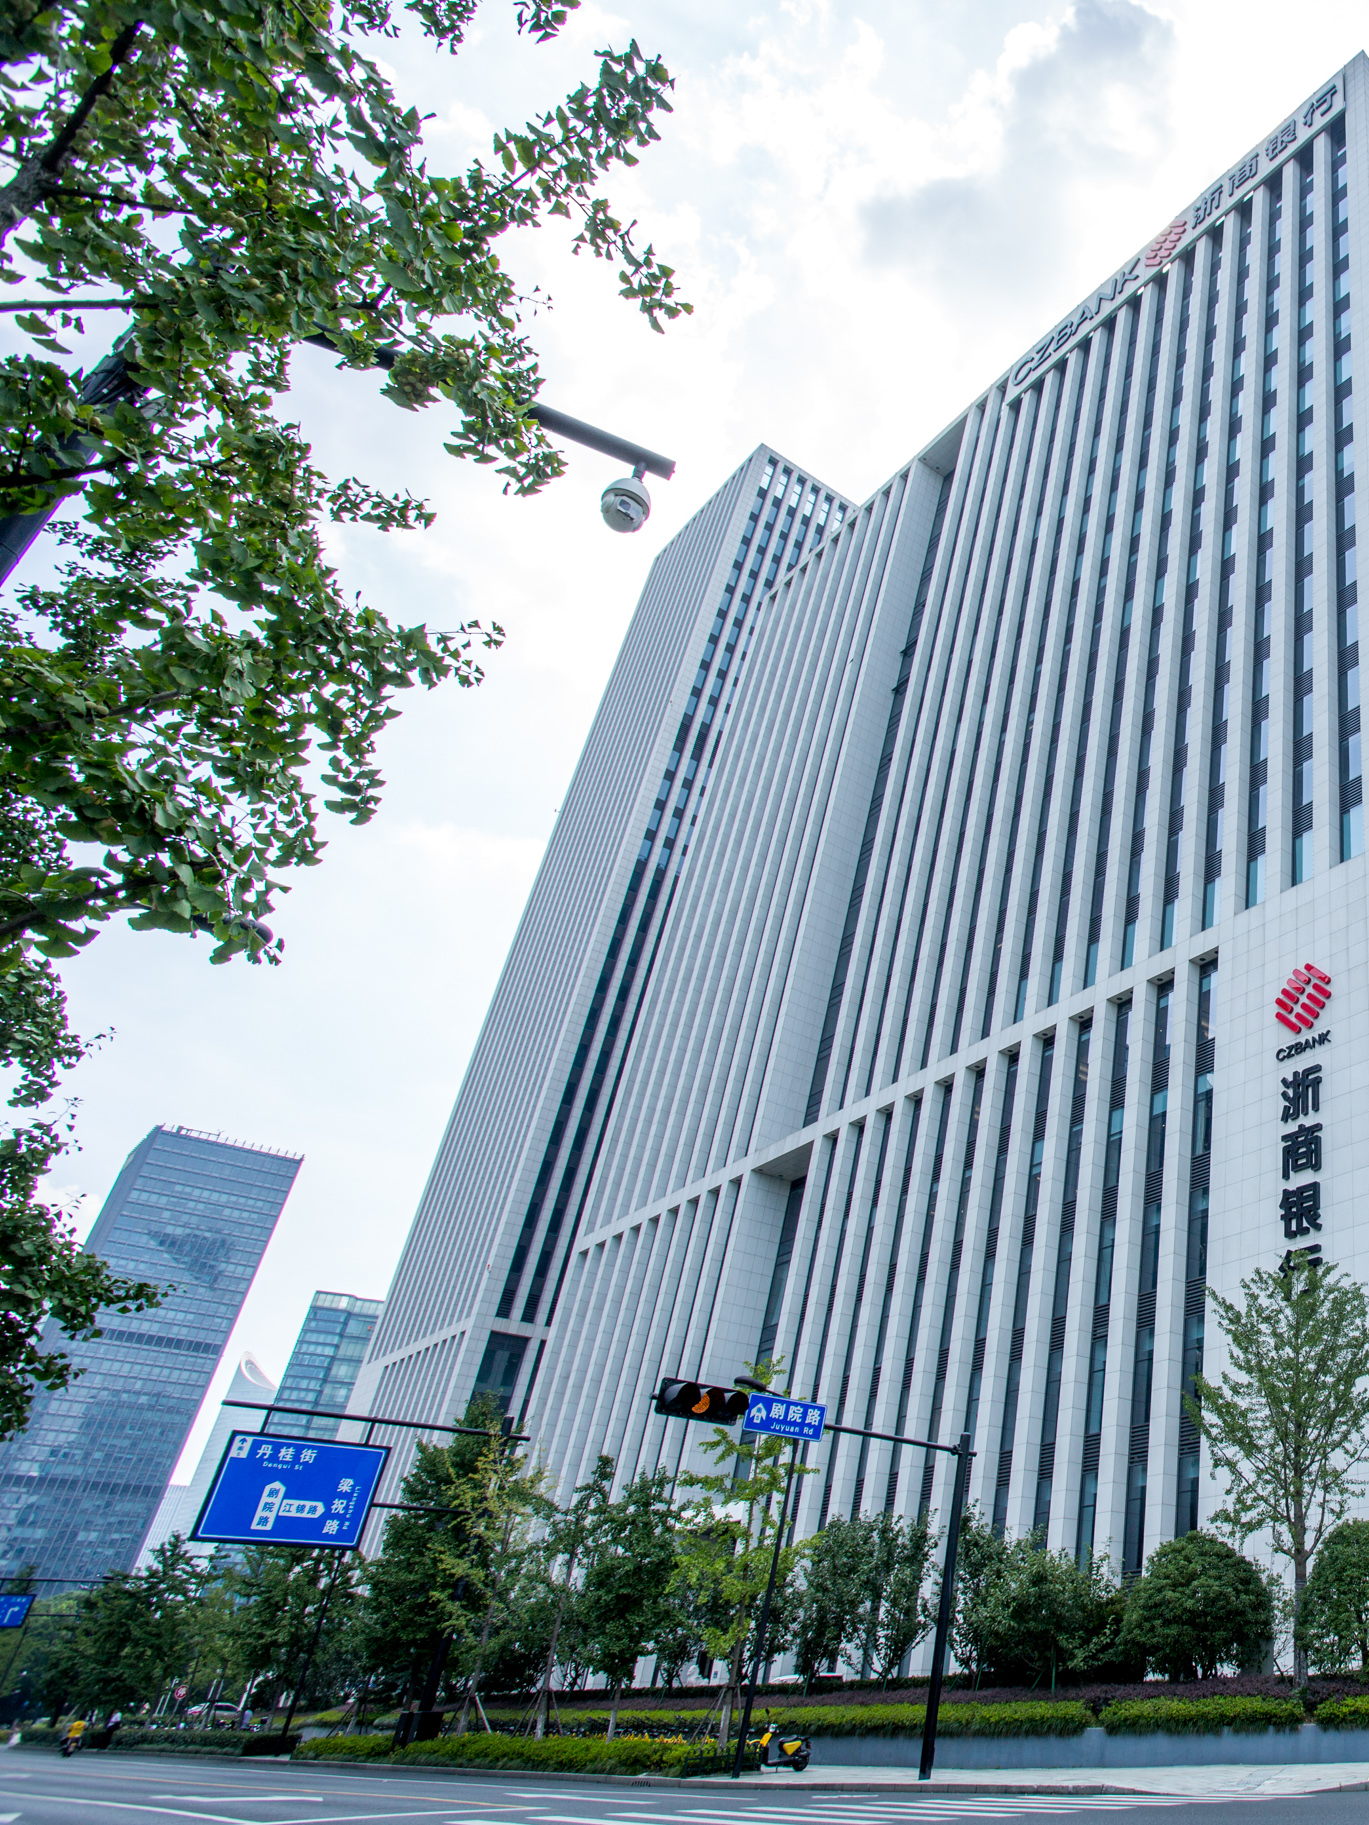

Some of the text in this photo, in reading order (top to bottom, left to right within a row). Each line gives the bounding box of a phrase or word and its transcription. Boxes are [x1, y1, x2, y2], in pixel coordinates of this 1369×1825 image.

[1191, 84, 1338, 230] 浙商银行
[1010, 257, 1141, 387] CZBANK
[1275, 1030, 1332, 1062] CZBANK
[769, 1402, 821, 1426] 剧院路
[770, 1422, 814, 1435] Juyuan Rd
[255, 1444, 318, 1464] 丹桂街
[262, 1461, 291, 1470] Dangui
[256, 1487, 281, 1527] 剧院路
[281, 1503, 319, 1515] 江锦路
[322, 1477, 355, 1535] 梁祝路
